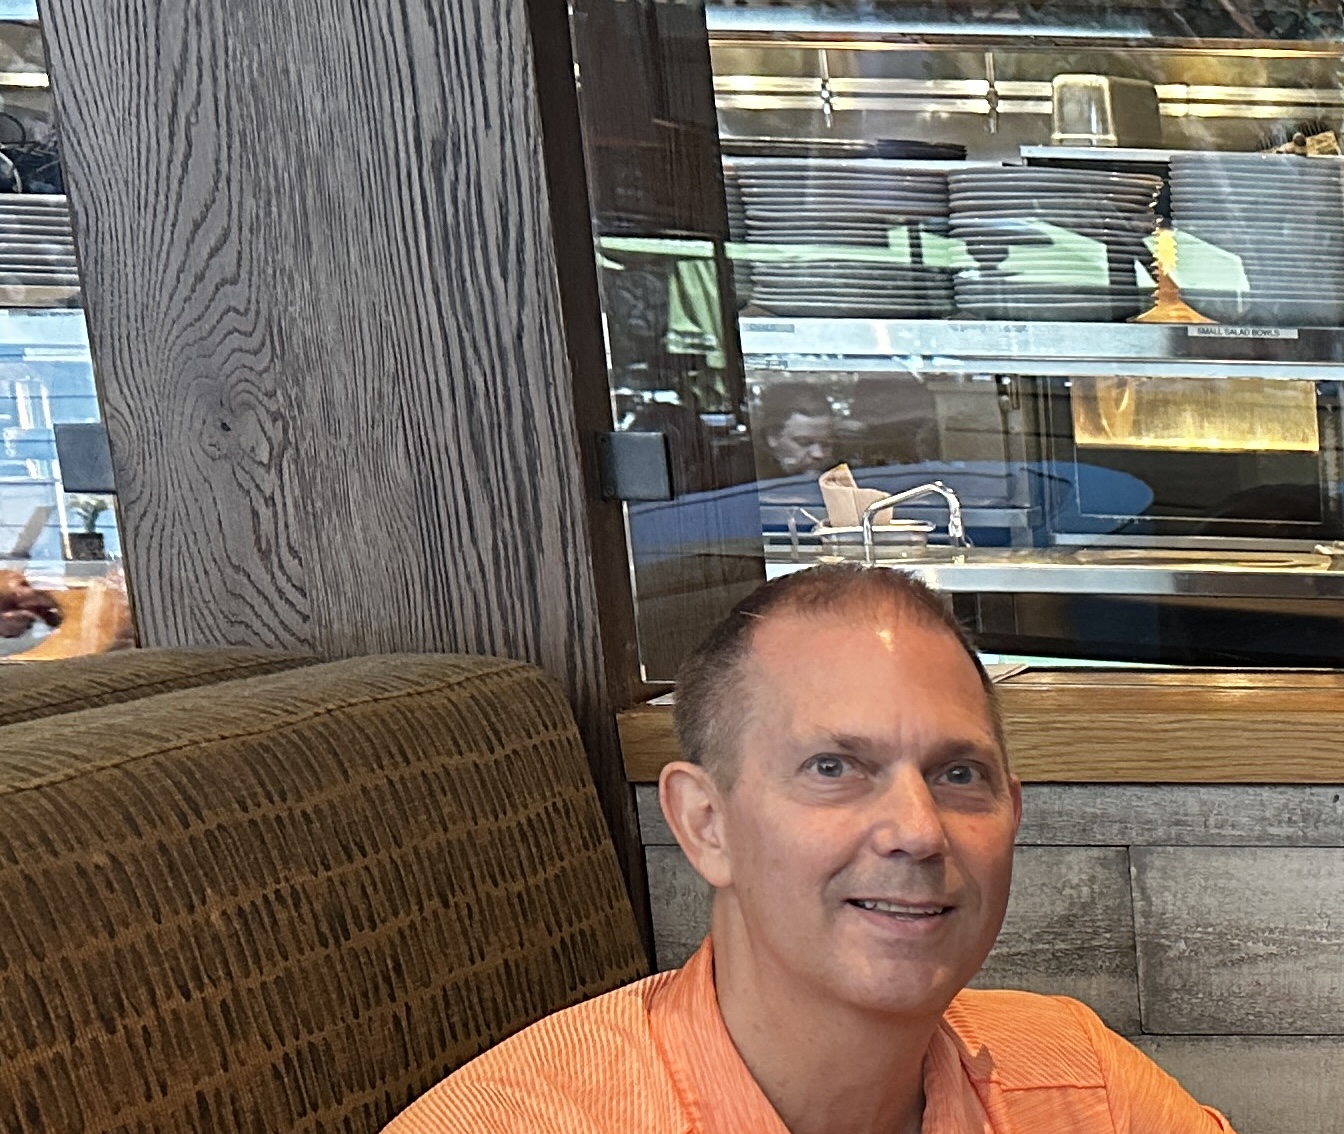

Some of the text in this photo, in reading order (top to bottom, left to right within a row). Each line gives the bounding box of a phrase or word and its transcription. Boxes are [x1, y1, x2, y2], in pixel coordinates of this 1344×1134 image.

[1197, 326, 1281, 337] SMALL SALAD BOWLS
